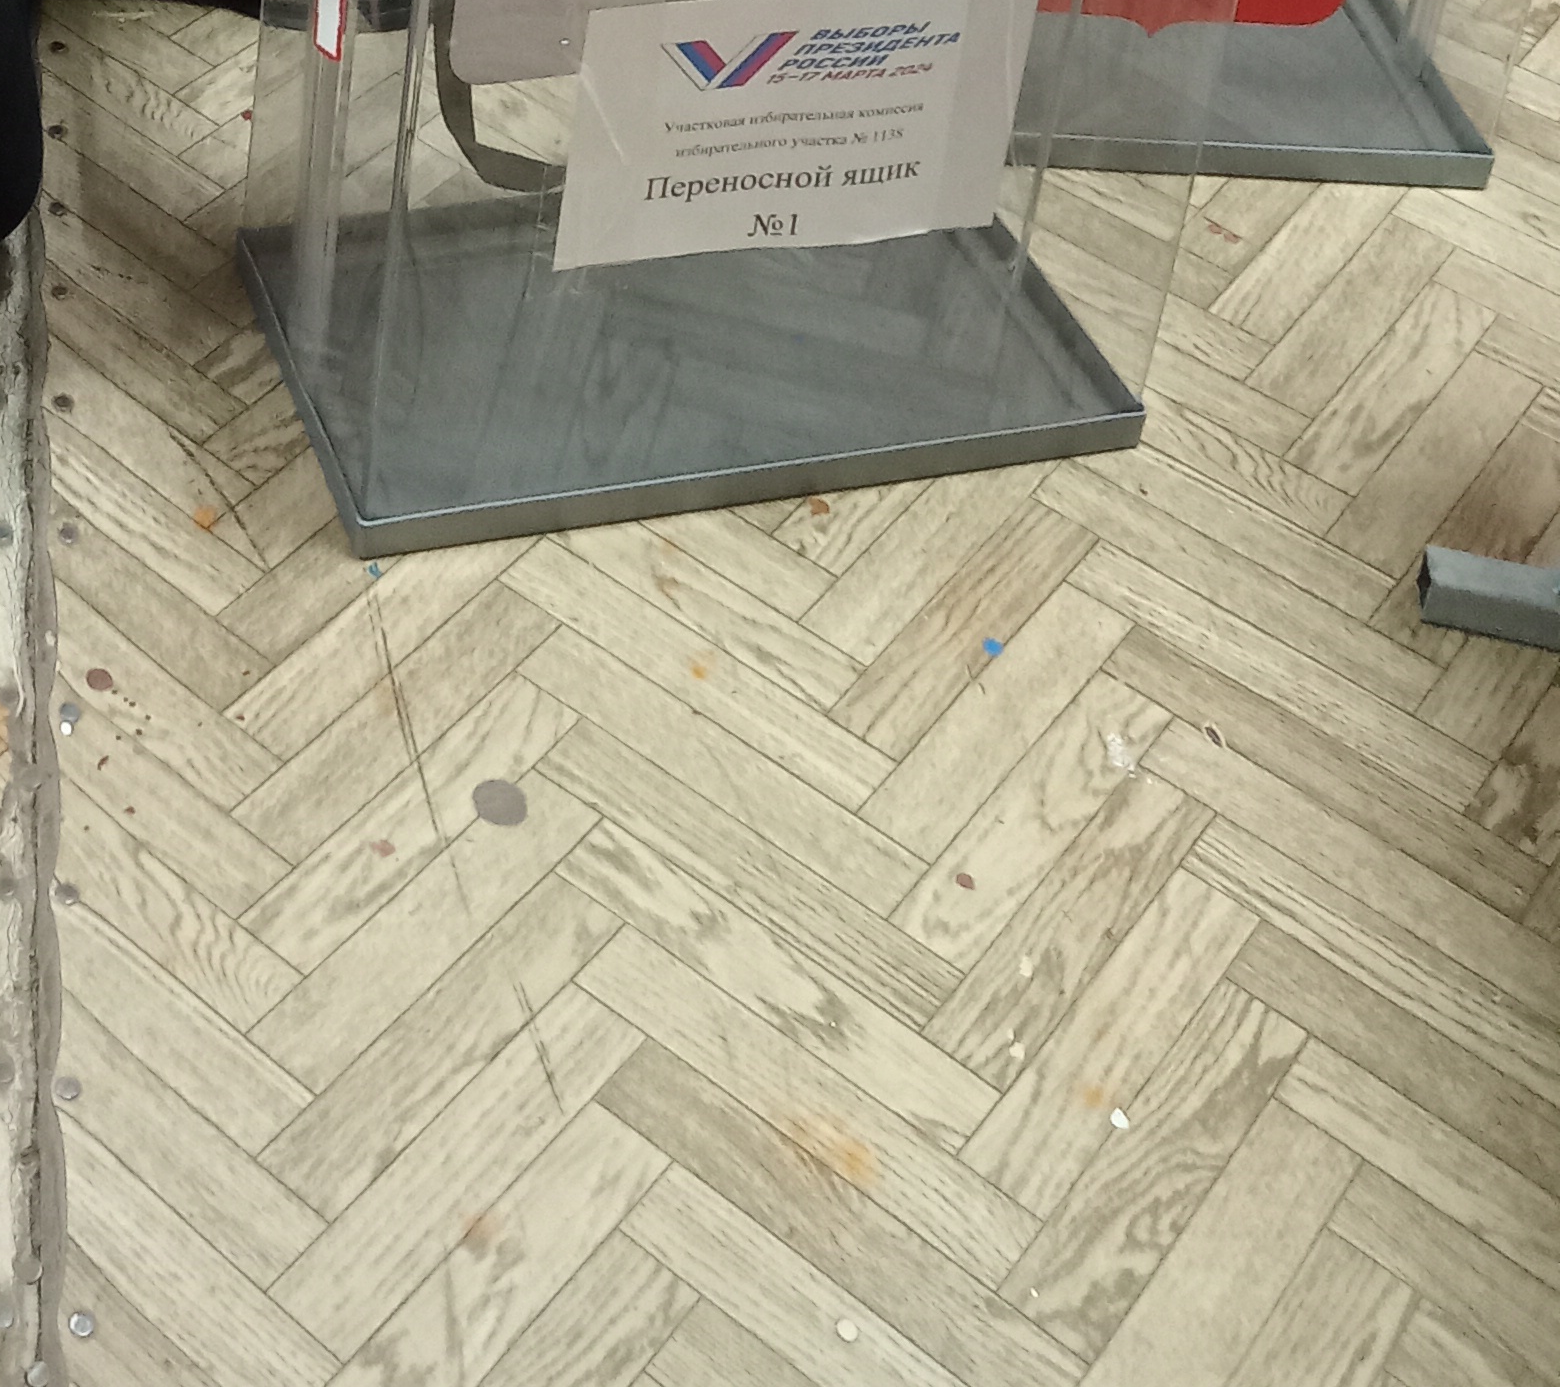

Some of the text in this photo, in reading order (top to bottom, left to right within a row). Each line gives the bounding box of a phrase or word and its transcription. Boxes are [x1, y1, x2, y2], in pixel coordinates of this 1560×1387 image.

[810, 21, 931, 40] ВЫБОРЫ
[793, 31, 961, 56] ПРЕЗИДЕНТА
[777, 53, 890, 71] РОССИИ
[820, 67, 887, 82] МАРТА
[889, 62, 934, 77] 2024
[663, 102, 925, 134] Участковая избирательная комиссия
[675, 137, 788, 159] избирательного
[789, 134, 848, 150] участка
[643, 160, 922, 203] Переносной ящик
